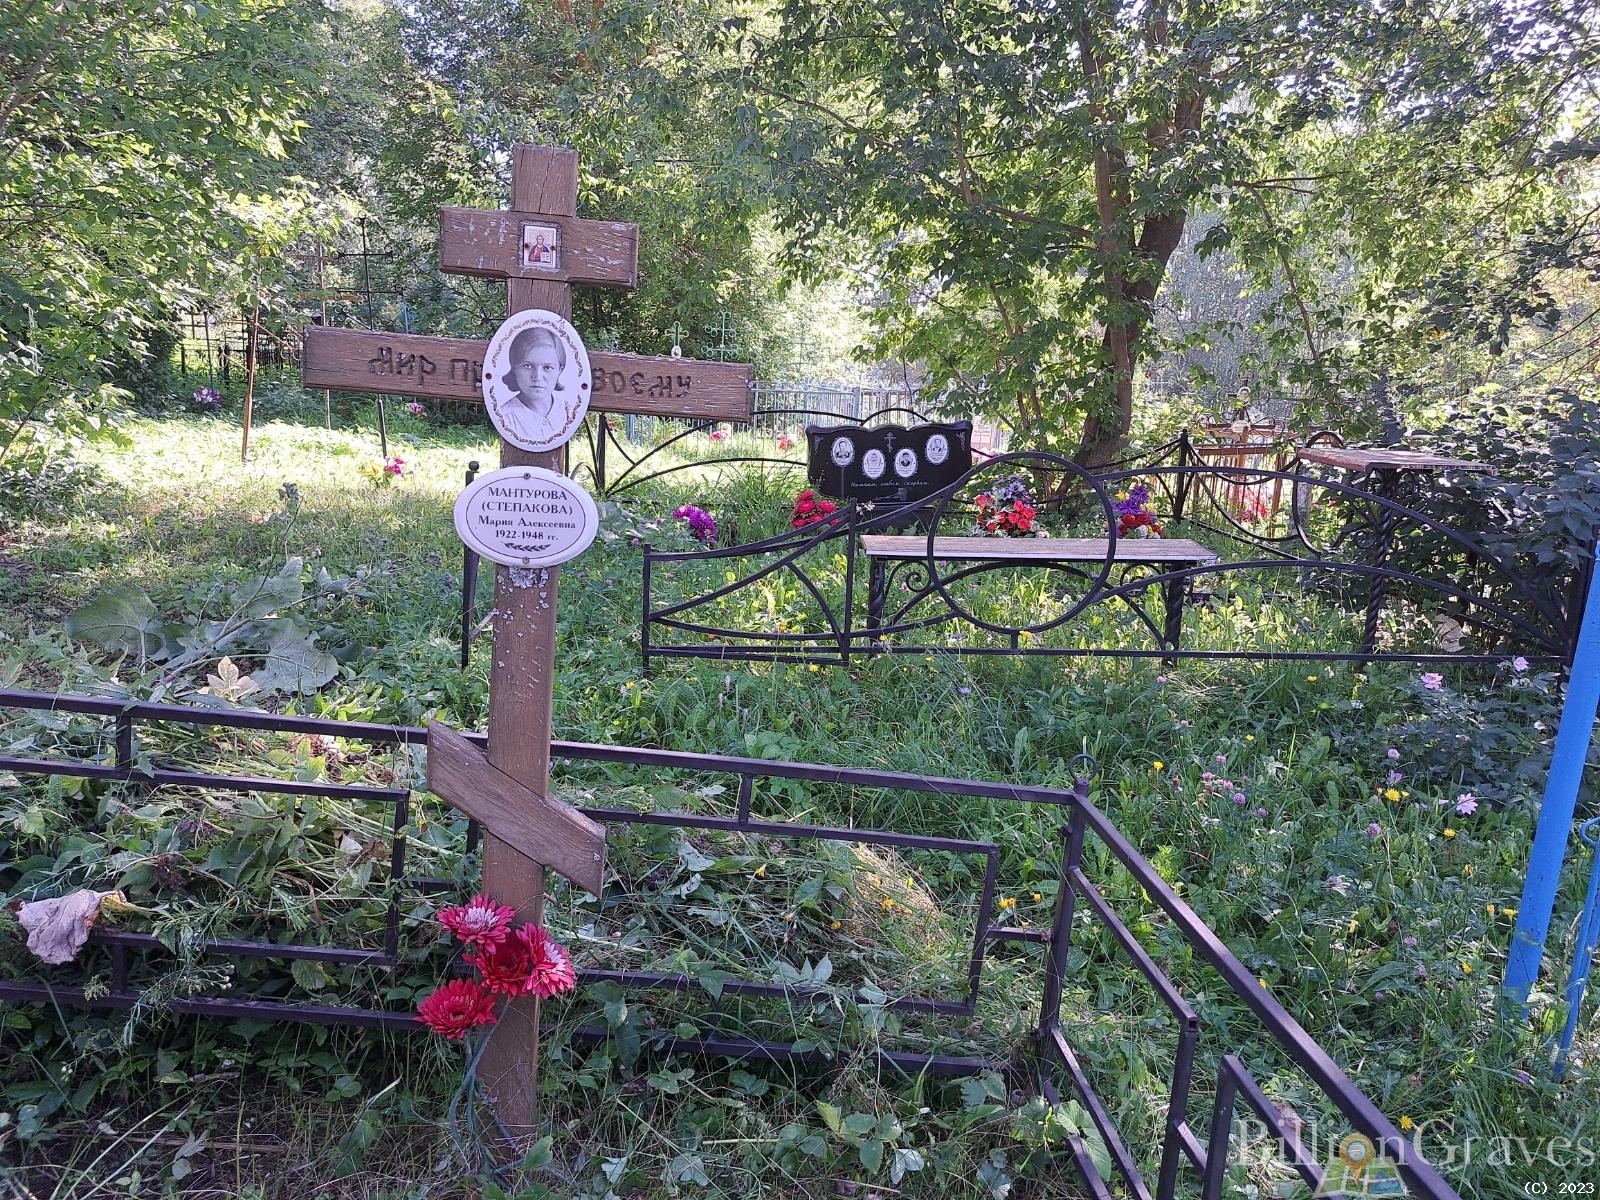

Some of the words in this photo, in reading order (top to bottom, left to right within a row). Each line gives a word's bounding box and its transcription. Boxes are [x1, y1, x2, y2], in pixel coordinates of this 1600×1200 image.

[488, 486, 567, 500] МАНТУРОВА
[482, 501, 573, 516] (СТЕПАКОВА)
[478, 515, 513, 527] Мария
[518, 517, 576, 529] Алексеевна
[495, 530, 544, 540] 1922-1948
